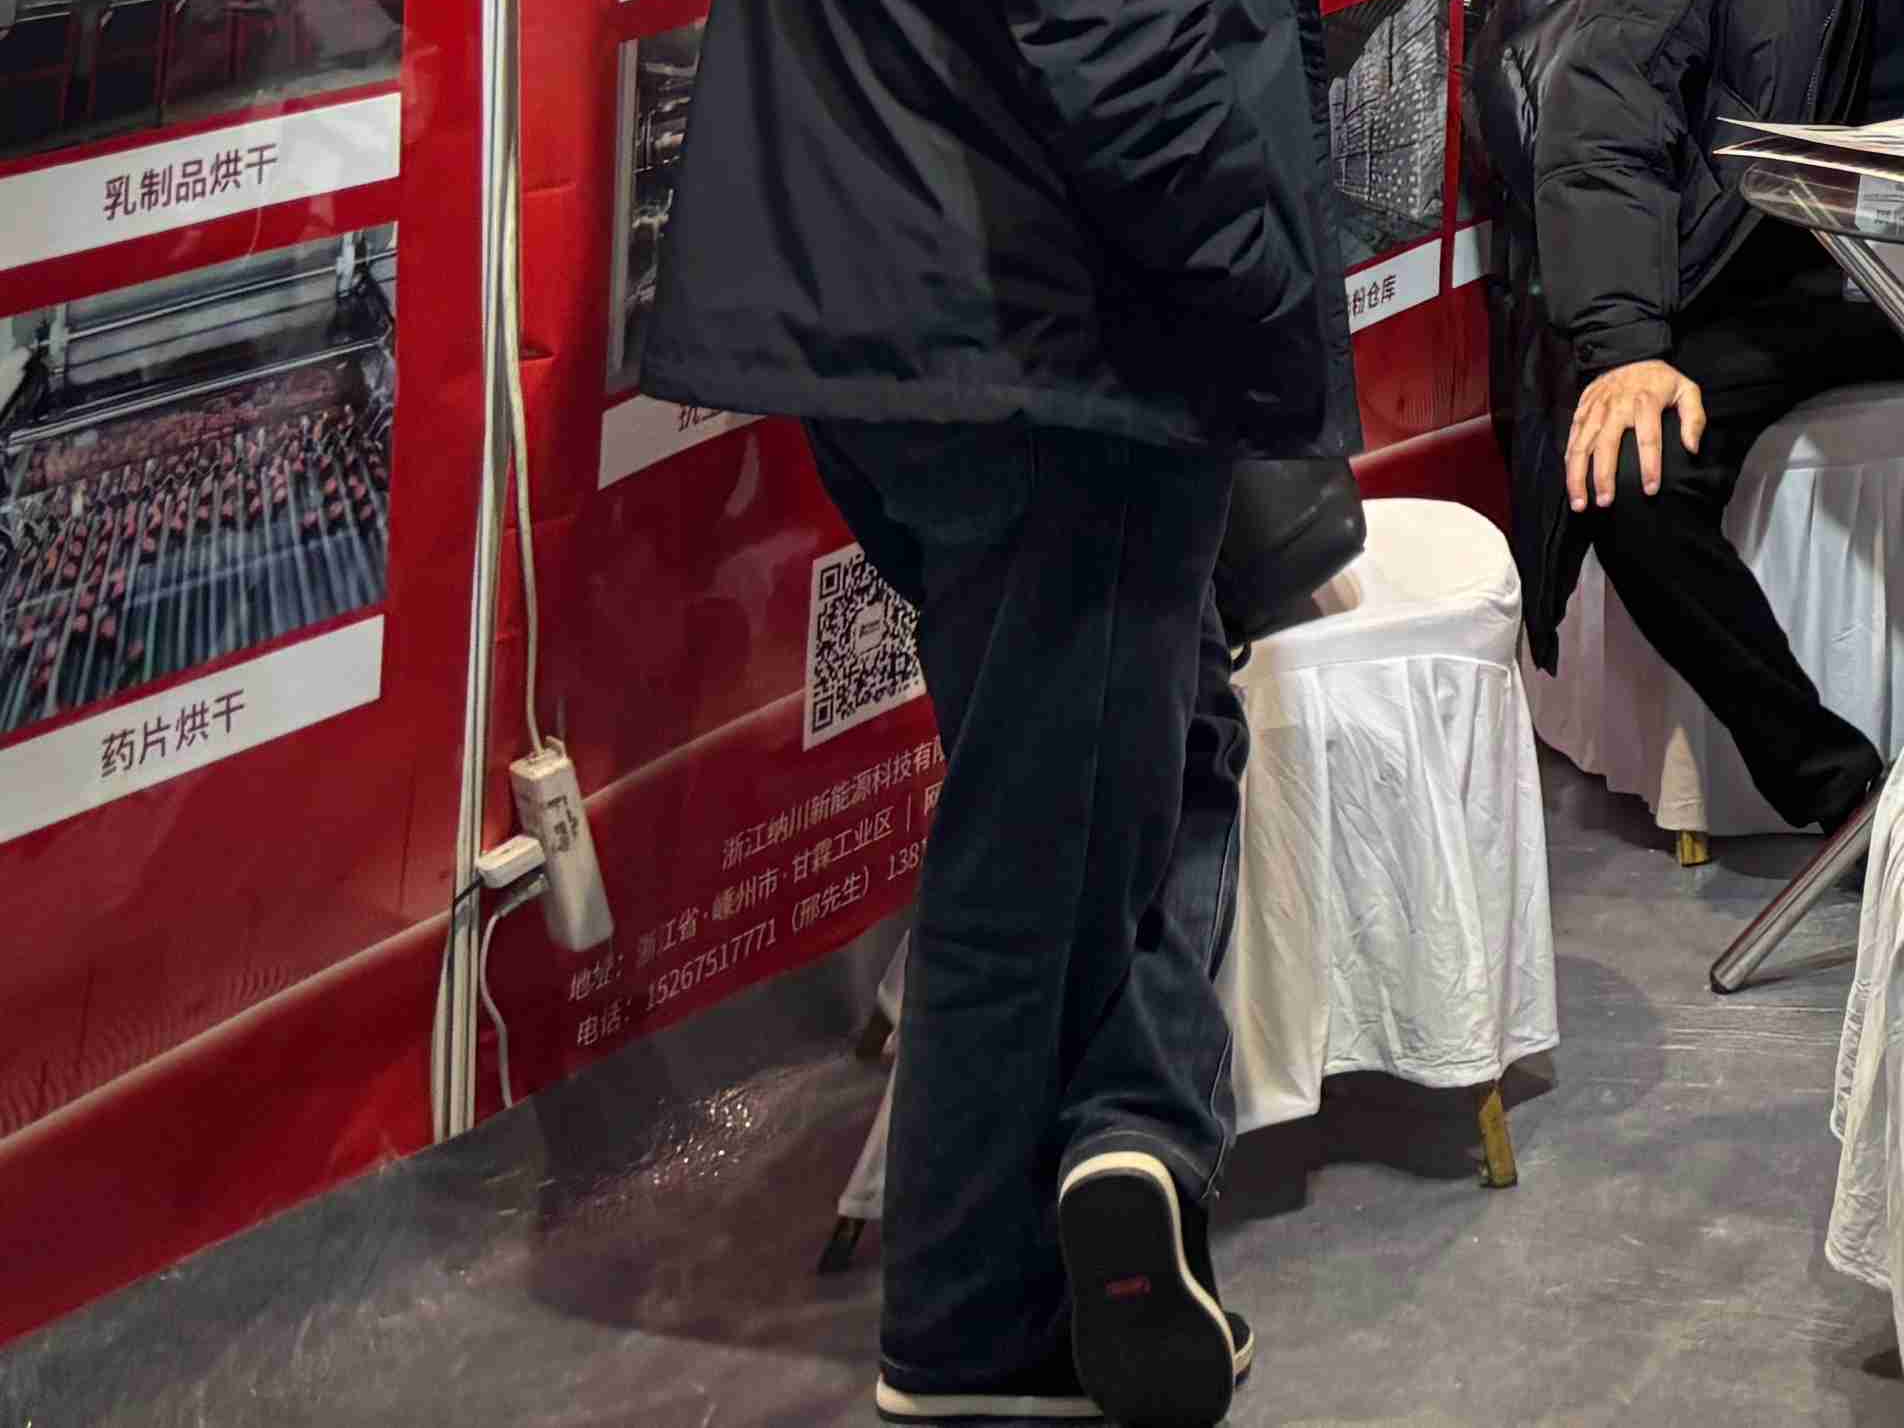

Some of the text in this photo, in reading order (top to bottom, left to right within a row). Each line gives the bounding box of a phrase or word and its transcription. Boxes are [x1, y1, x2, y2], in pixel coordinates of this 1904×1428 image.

[102, 141, 278, 223] 乳制品烘干
[100, 687, 246, 779] 药片烘干
